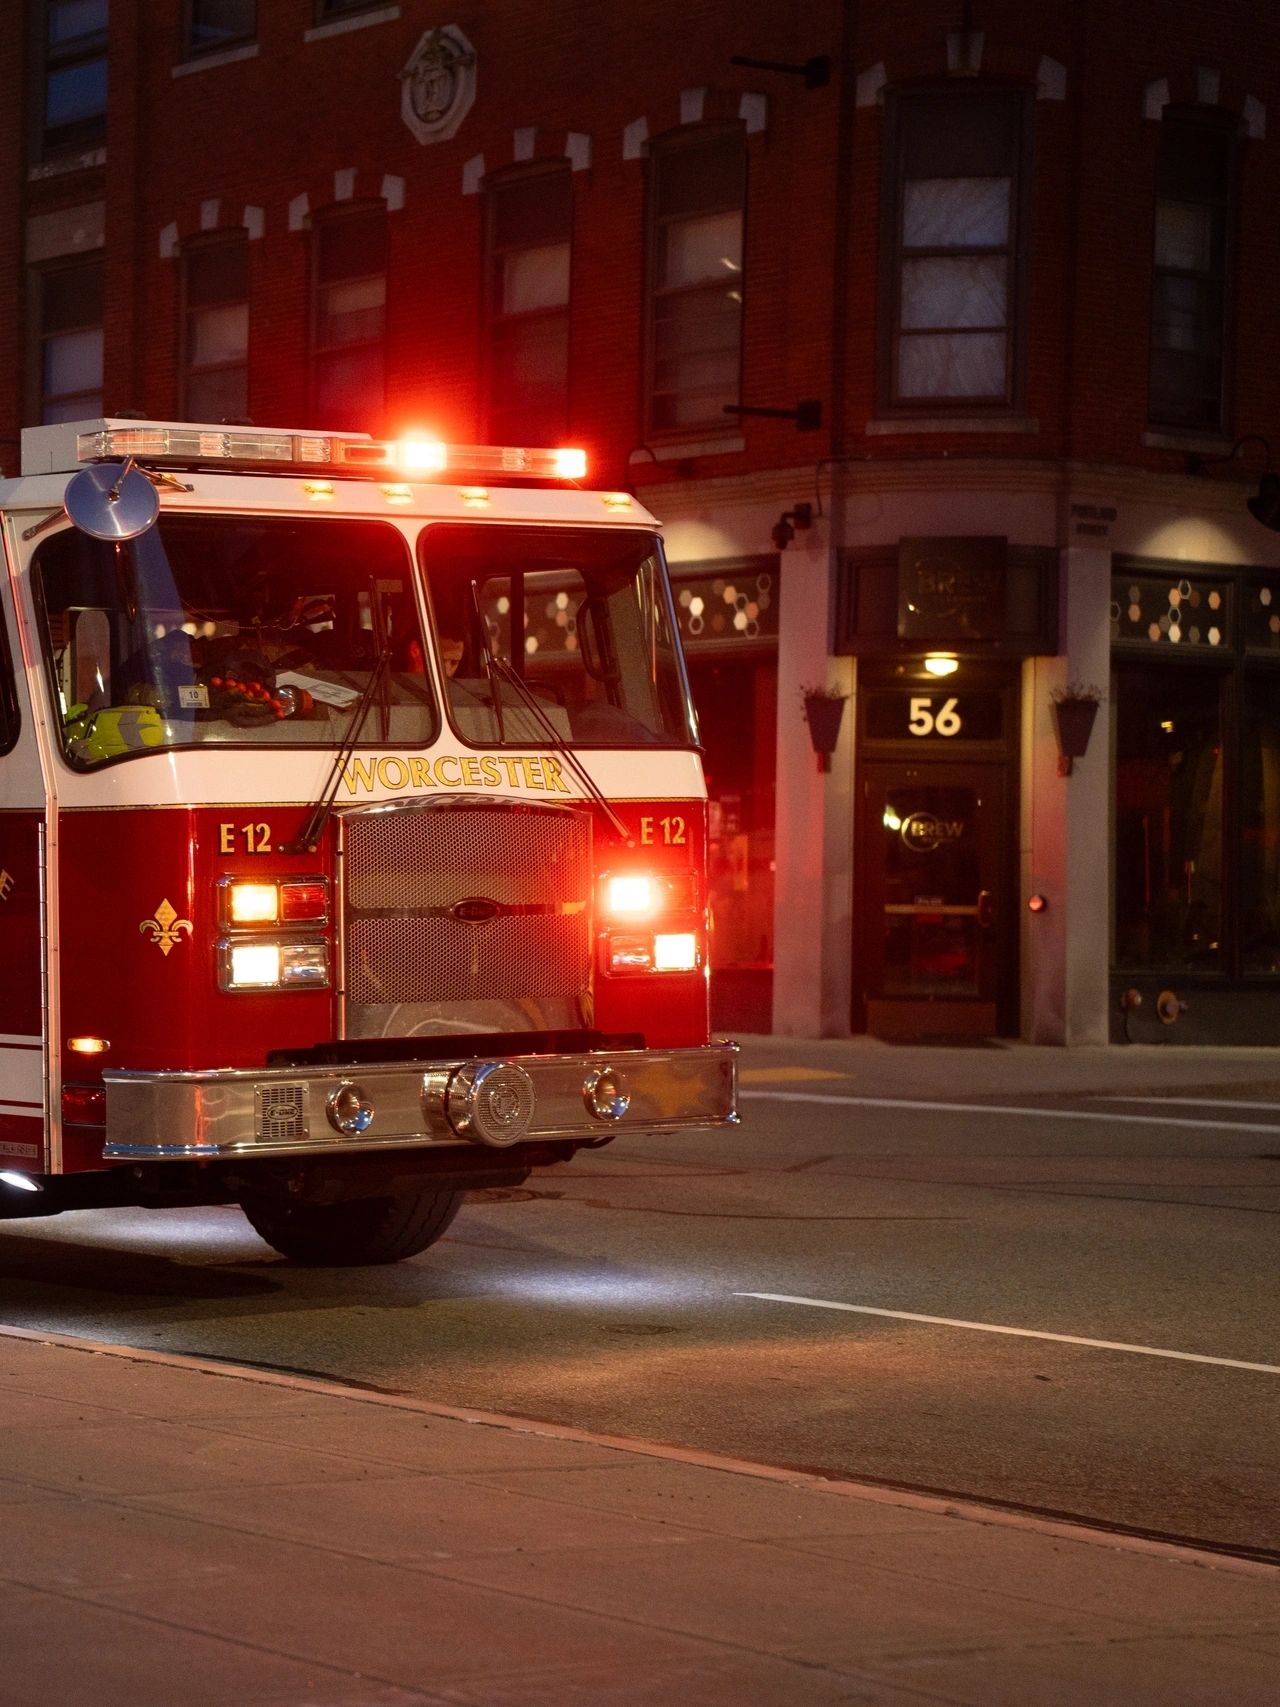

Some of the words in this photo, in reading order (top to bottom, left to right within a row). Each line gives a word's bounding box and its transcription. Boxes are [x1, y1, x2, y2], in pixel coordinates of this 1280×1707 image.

[908, 698, 962, 737] 56
[335, 755, 570, 795] WORCESTER
[220, 823, 235, 853] E
[241, 823, 272, 853] 12
[640, 816, 654, 845] E
[659, 816, 686, 845] 12
[911, 820, 964, 837] BREW
